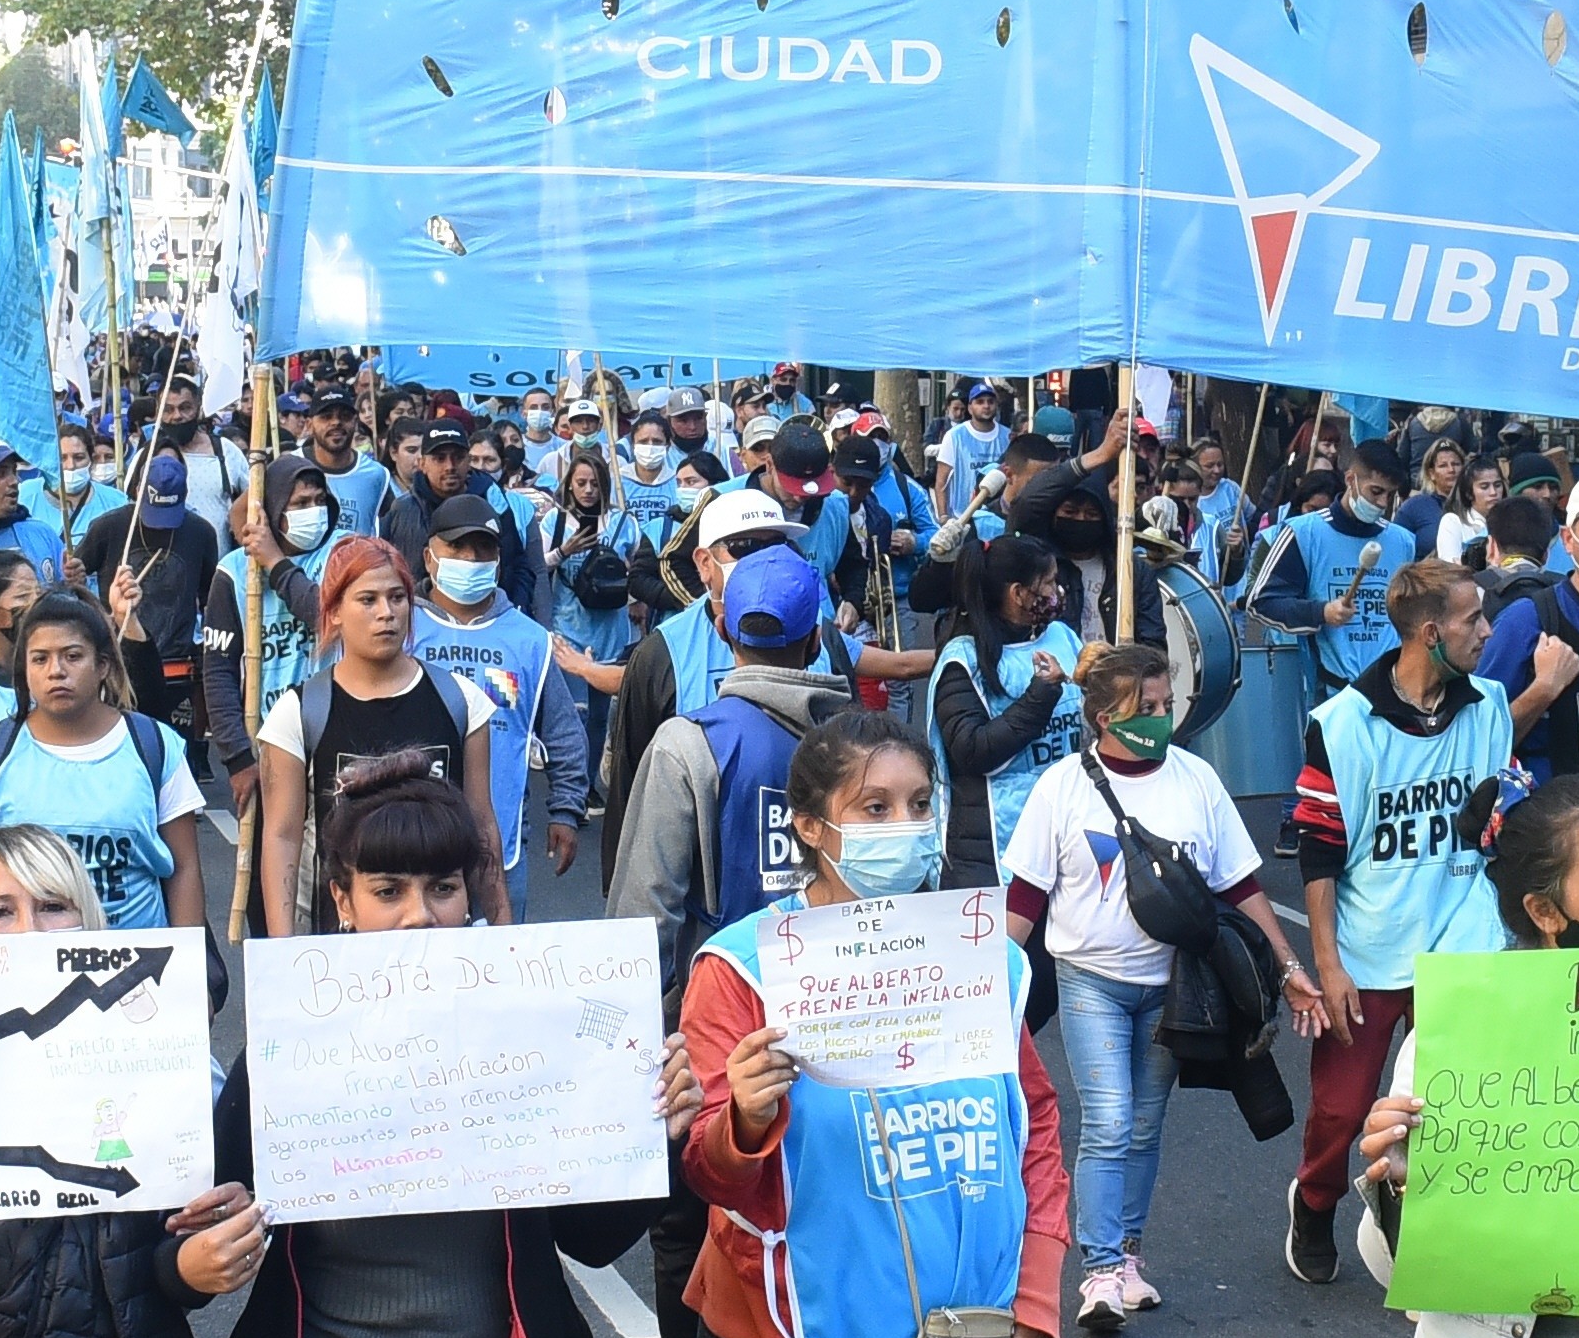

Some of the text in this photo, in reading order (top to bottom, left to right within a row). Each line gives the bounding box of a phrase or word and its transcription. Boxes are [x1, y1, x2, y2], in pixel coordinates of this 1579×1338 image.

[635, 35, 943, 87] CIUDAD
[1363, 601, 1387, 616] PIE
[425, 645, 504, 666] BARRIOS
[1032, 740, 1066, 766] DE
[1378, 773, 1475, 821] BARRIOS
[1372, 819, 1419, 863] DE
[841, 898, 896, 918] BASTA
[857, 918, 884, 933] DE
[834, 934, 926, 958] INFLACIÓN
[56, 946, 133, 973] PRECIOS
[292, 947, 437, 1019] Basta
[454, 955, 499, 992] De
[799, 964, 944, 997] QUE ALBERTO
[779, 994, 858, 1020] FRENE
[866, 991, 889, 1008] LA
[797, 1019, 843, 1036] PORQUE
[848, 1015, 871, 1030] CON
[875, 1013, 901, 1028] ELLA
[798, 1035, 858, 1051] LOS RICOS
[961, 1050, 989, 1065] SUR
[863, 1096, 999, 1143] BARRIOS
[267, 1125, 398, 1162] agropecuarias
[409, 1118, 451, 1145] para
[869, 1130, 998, 1187] DE PIE
[1449, 1160, 1489, 1196] Se
[56, 1192, 101, 1209] REAL
[266, 1189, 338, 1214] Derecho
[491, 1180, 572, 1206] Barrios
